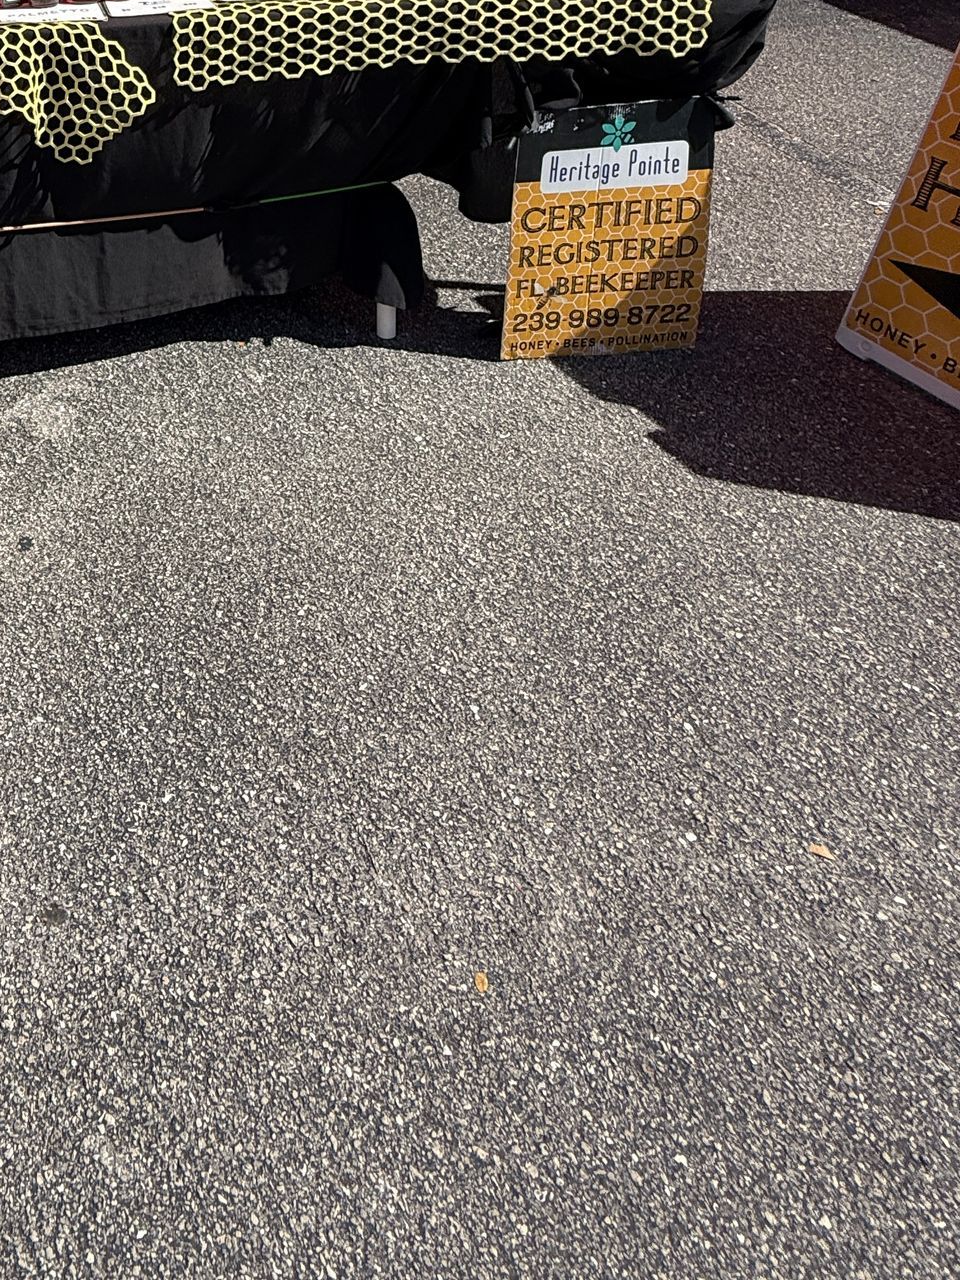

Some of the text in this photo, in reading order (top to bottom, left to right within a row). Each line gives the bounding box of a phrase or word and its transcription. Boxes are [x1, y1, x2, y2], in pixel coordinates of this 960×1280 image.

[549, 146, 680, 185] Heritage Pointe
[520, 197, 702, 234] CERTIFIED
[518, 235, 699, 268] REGISTERED
[516, 270, 695, 299] FL BEEKEEPER
[512, 303, 691, 333] 239-989-8722
[855, 308, 928, 355] HONEY
[510, 332, 688, 352] HONEY BEES POLLINATION
